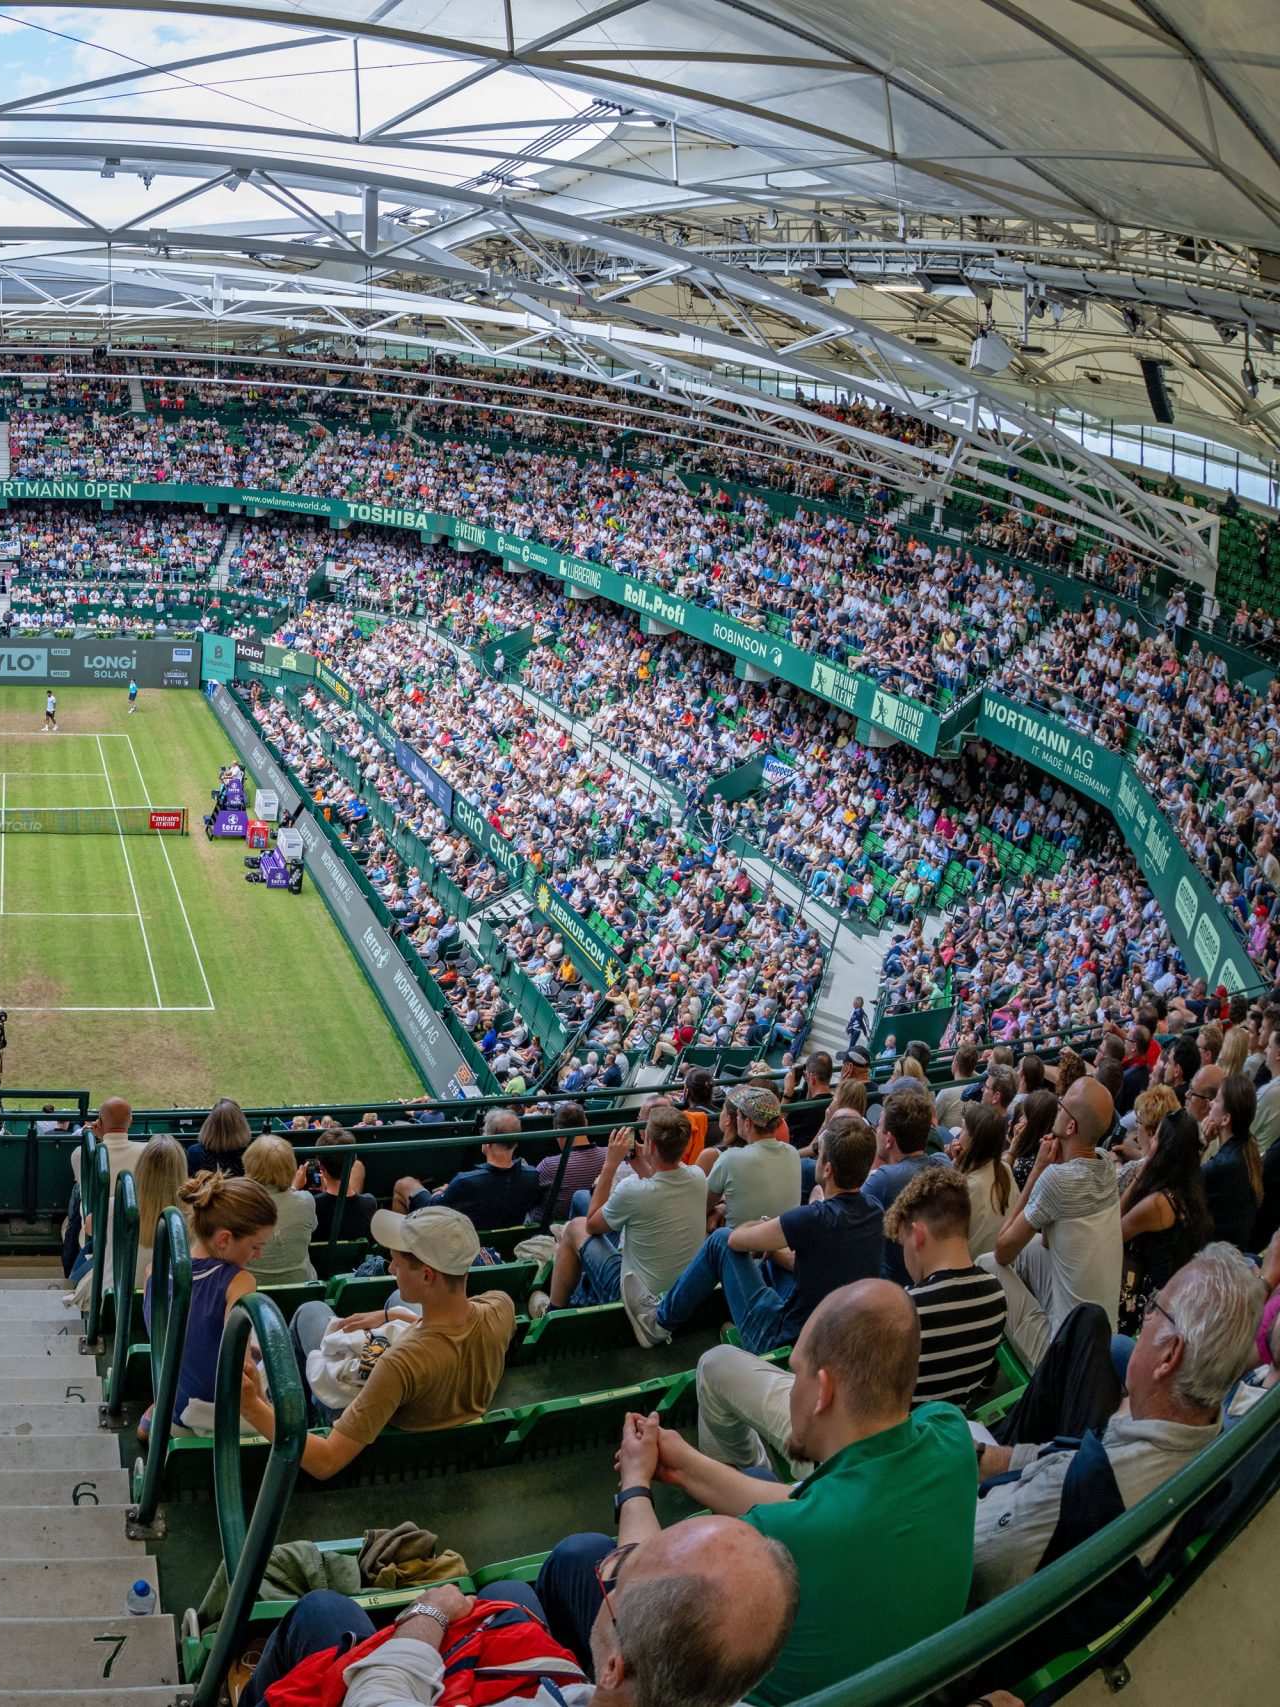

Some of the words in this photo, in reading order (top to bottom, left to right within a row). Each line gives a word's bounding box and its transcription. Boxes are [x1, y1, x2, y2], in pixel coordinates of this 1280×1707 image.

[84, 482, 132, 498] OPEN
[242, 494, 331, 512] www.owlarena-world.de
[347, 503, 428, 529] TOSHIBA
[460, 523, 485, 545] VELTINS
[505, 542, 521, 555] COREGO
[530, 553, 547, 565] COREGO
[713, 623, 767, 658] ROBINSON
[237, 645, 264, 659] Haier
[94, 670, 127, 679] SOLAR
[835, 674, 858, 694] BRUNO
[832, 688, 855, 709] KLEINE
[898, 702, 923, 725] BRUNO
[894, 716, 920, 743] KLEINE
[984, 698, 1070, 755] WORTMANN
[1072, 745, 1093, 770] AG
[765, 760, 794, 777] Knoppers
[1031, 745, 1041, 759] IT.
[1042, 752, 1063, 769] MADE
[1064, 763, 1072, 775] IN
[1074, 768, 1111, 799] GERMANY.
[222, 823, 242, 831] terra
[457, 800, 484, 839] CHiQ
[300, 823, 315, 845] terra
[489, 834, 518, 877] CHiQ
[321, 851, 347, 891] WORTMANN
[363, 926, 382, 958] terra
[550, 899, 605, 966] MERKUR.COM
[393, 968, 431, 1029] WORTMANN
[425, 1025, 440, 1045] AG
[447, 1079, 459, 1097] 0:19
[65, 1386, 86, 1404] 5
[72, 1482, 100, 1506] 6
[368, 1596, 379, 1606] 31
[93, 1635, 128, 1678] 7
